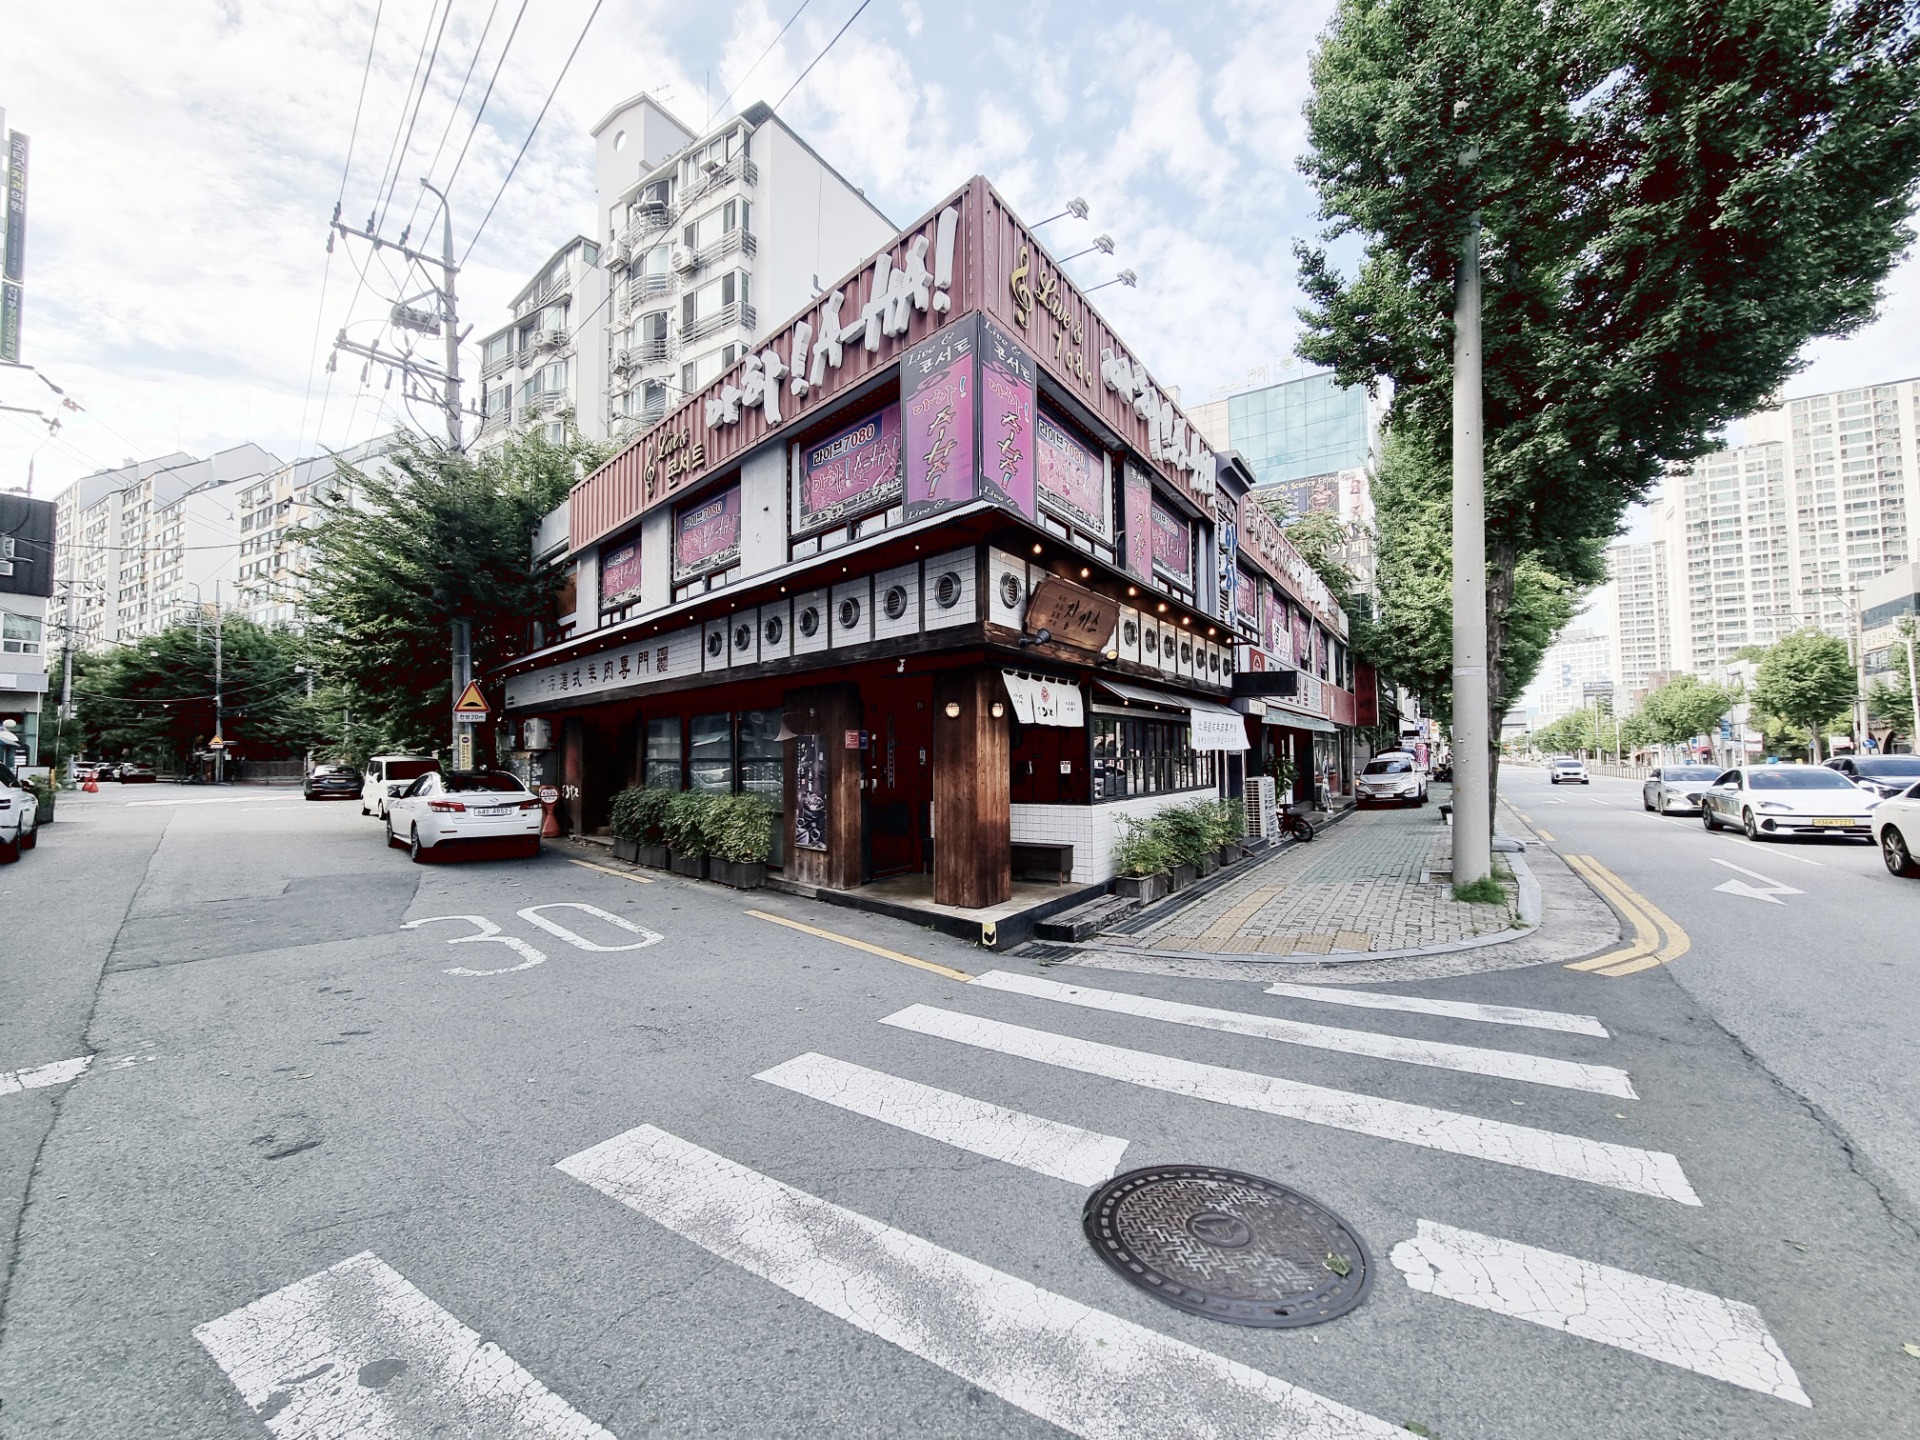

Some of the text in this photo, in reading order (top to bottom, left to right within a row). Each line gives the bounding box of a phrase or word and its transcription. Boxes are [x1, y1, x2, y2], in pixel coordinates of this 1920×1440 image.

[1034, 270, 1072, 330] Live
[984, 320, 1009, 347] Live
[908, 344, 935, 367] Live
[918, 336, 972, 374] 콘서트
[993, 340, 1032, 384] 콘서트
[911, 375, 967, 416] 아하!
[667, 441, 706, 489] 콘서트
[812, 423, 875, 466] 라이브7080
[907, 505, 931, 521] Live
[984, 485, 1005, 502] Live
[399, 901, 665, 977] 30
